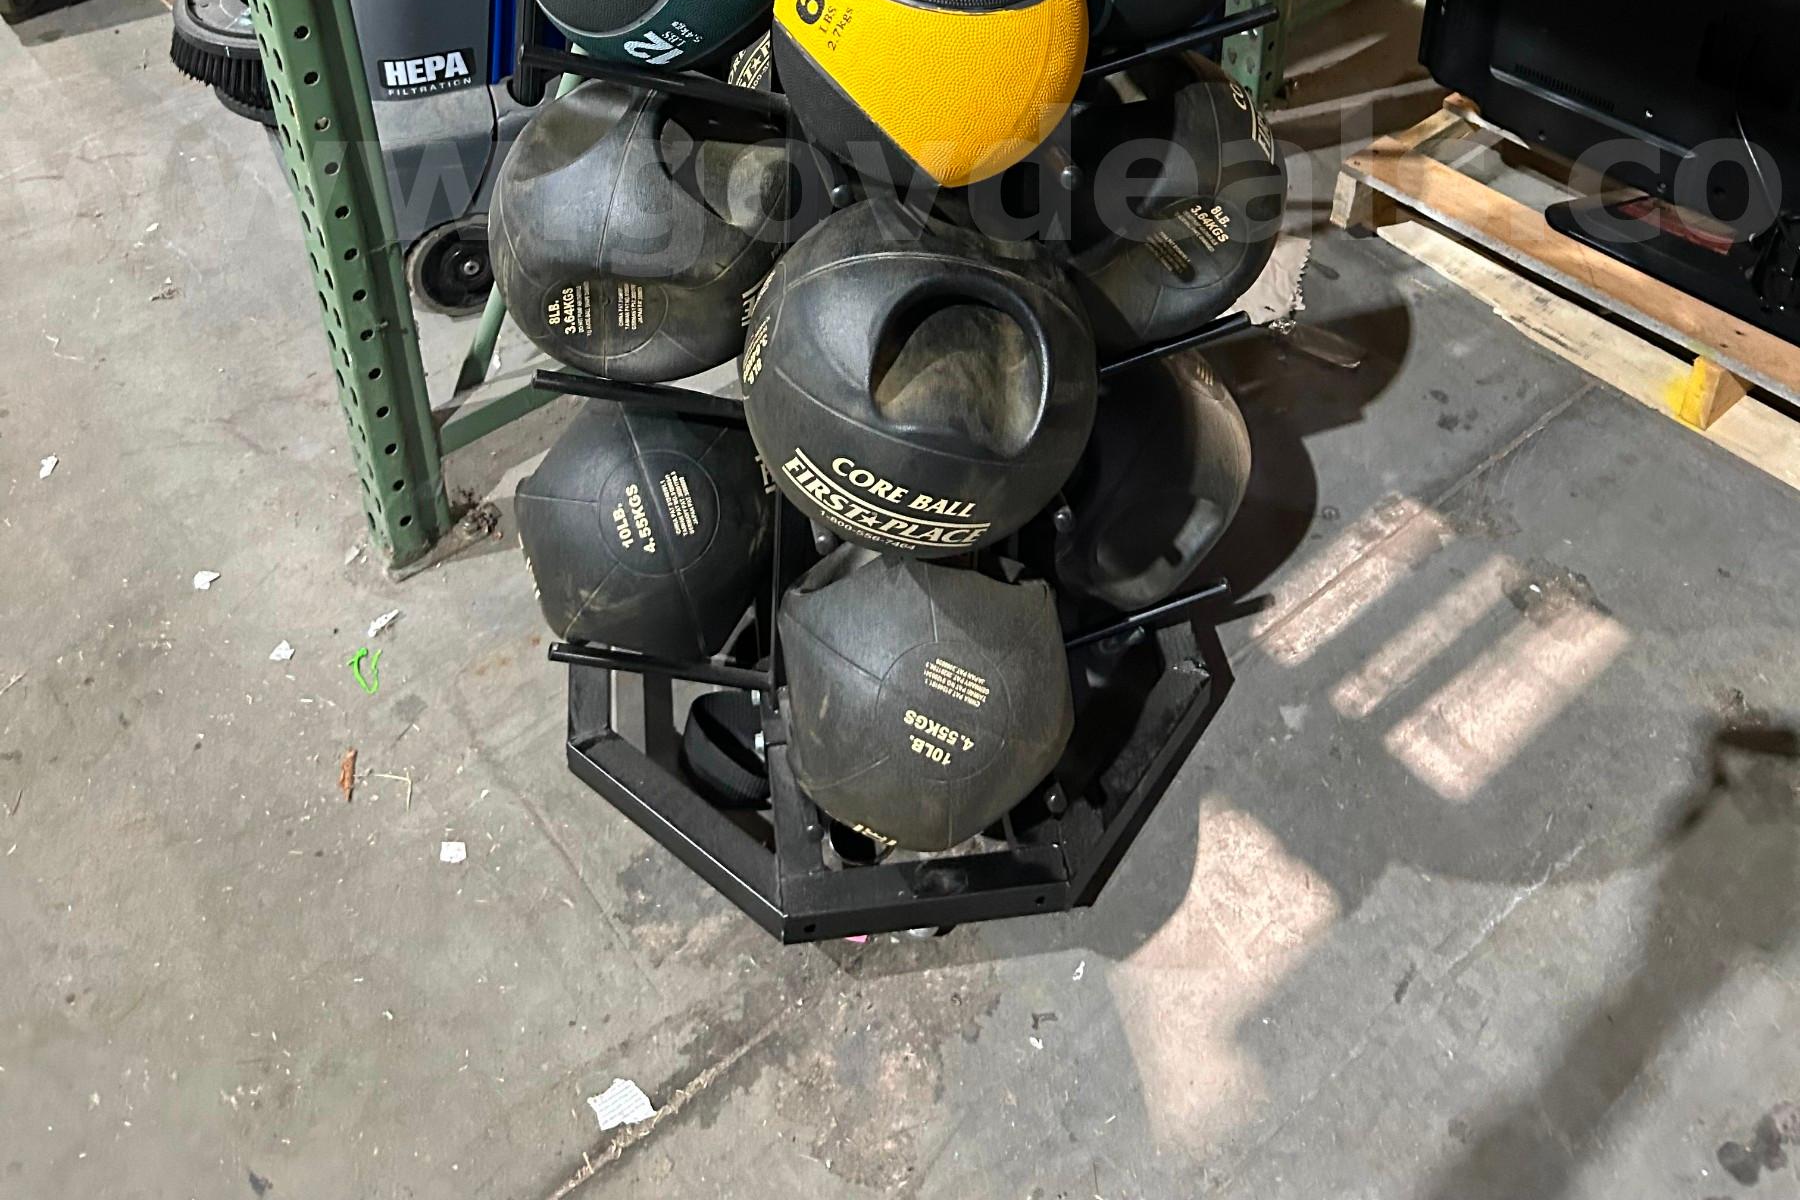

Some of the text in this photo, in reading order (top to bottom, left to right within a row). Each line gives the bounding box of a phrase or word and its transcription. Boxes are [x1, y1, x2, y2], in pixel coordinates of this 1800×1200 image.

[820, 6, 837, 33] LBS
[624, 30, 684, 65] 12
[383, 51, 470, 87] HEPA
[388, 77, 472, 96] FILTRATION
[1190, 205, 1229, 243] 3.64KGS
[1210, 205, 1230, 228] 8LB.
[548, 299, 561, 325] 8LB.
[562, 287, 577, 335] 3.64KGS
[784, 456, 871, 520] FIRST
[878, 518, 988, 543] PLACE
[832, 457, 976, 518] CORE BALL
[612, 502, 634, 549] 10LB.
[625, 484, 656, 553] 4.55KGS
[904, 710, 974, 751] 4.55KGS
[909, 734, 951, 766] 10LB.
